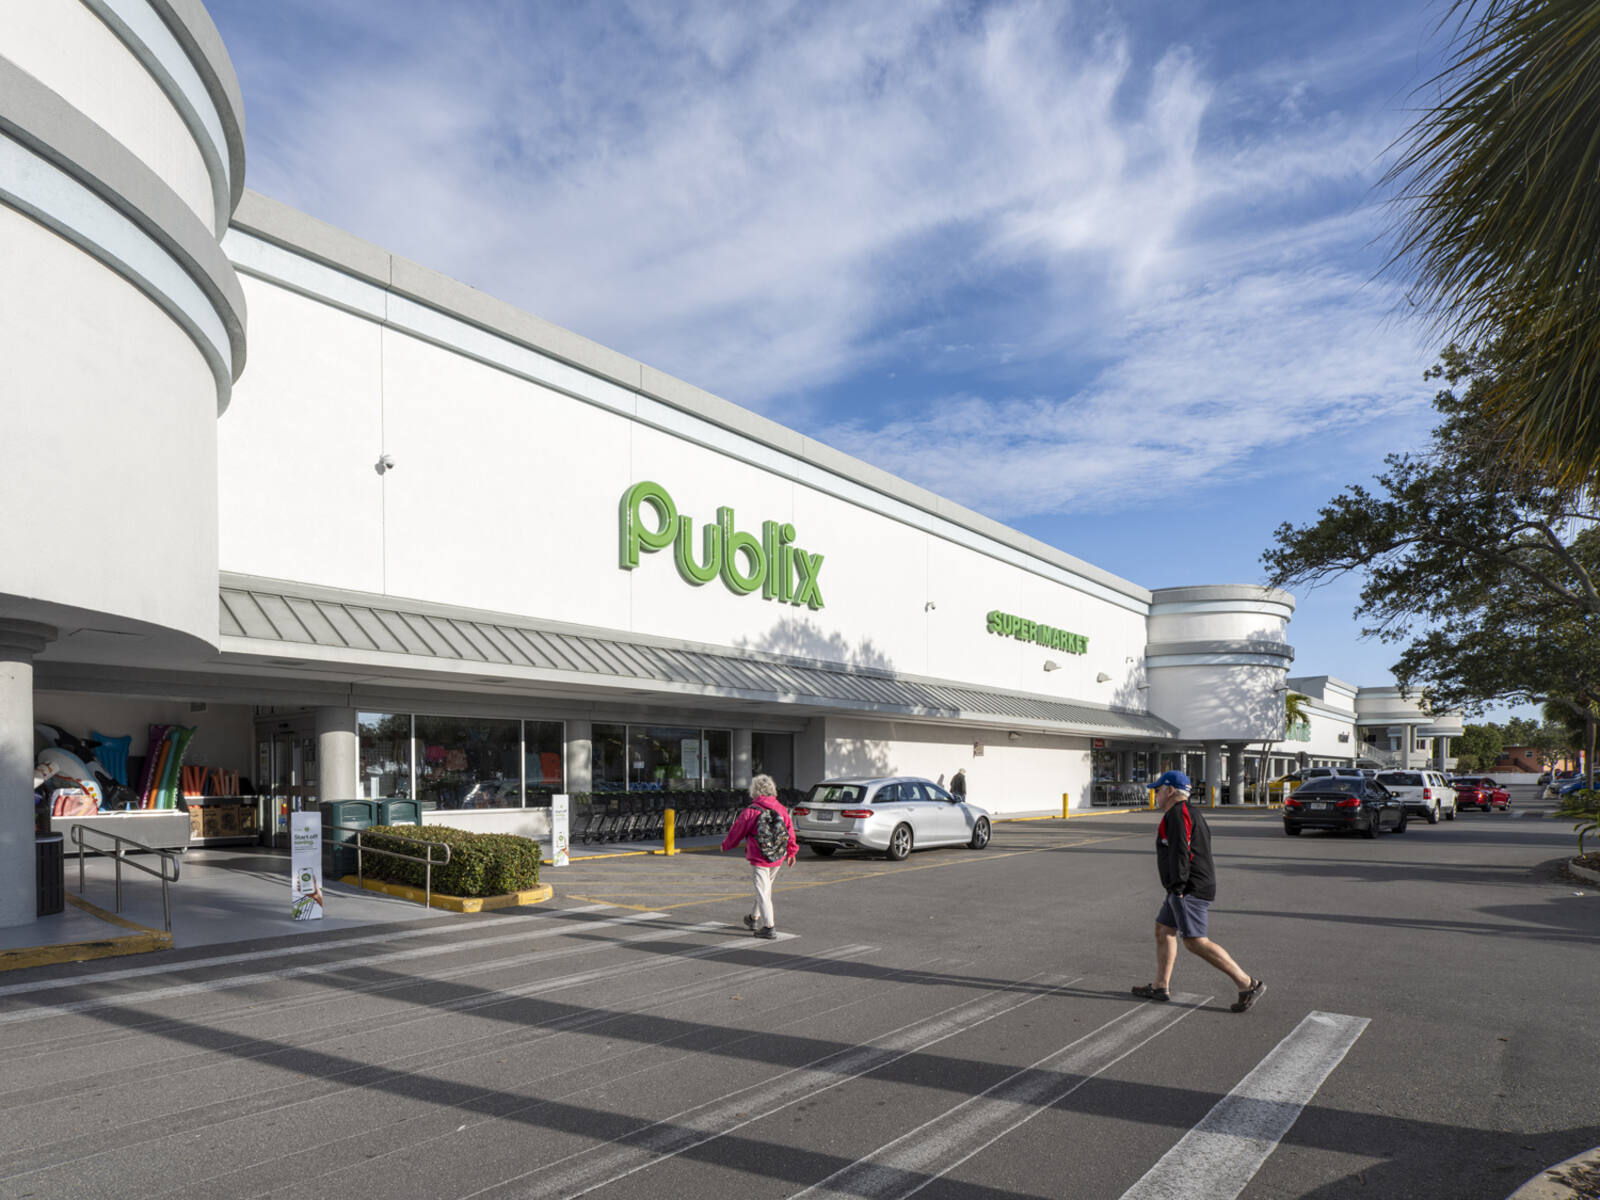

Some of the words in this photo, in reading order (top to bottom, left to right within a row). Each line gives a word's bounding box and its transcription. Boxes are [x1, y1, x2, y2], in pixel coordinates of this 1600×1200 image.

[619, 481, 825, 609] Publix
[987, 610, 1037, 642] SUPER
[1037, 624, 1089, 655] MARKET
